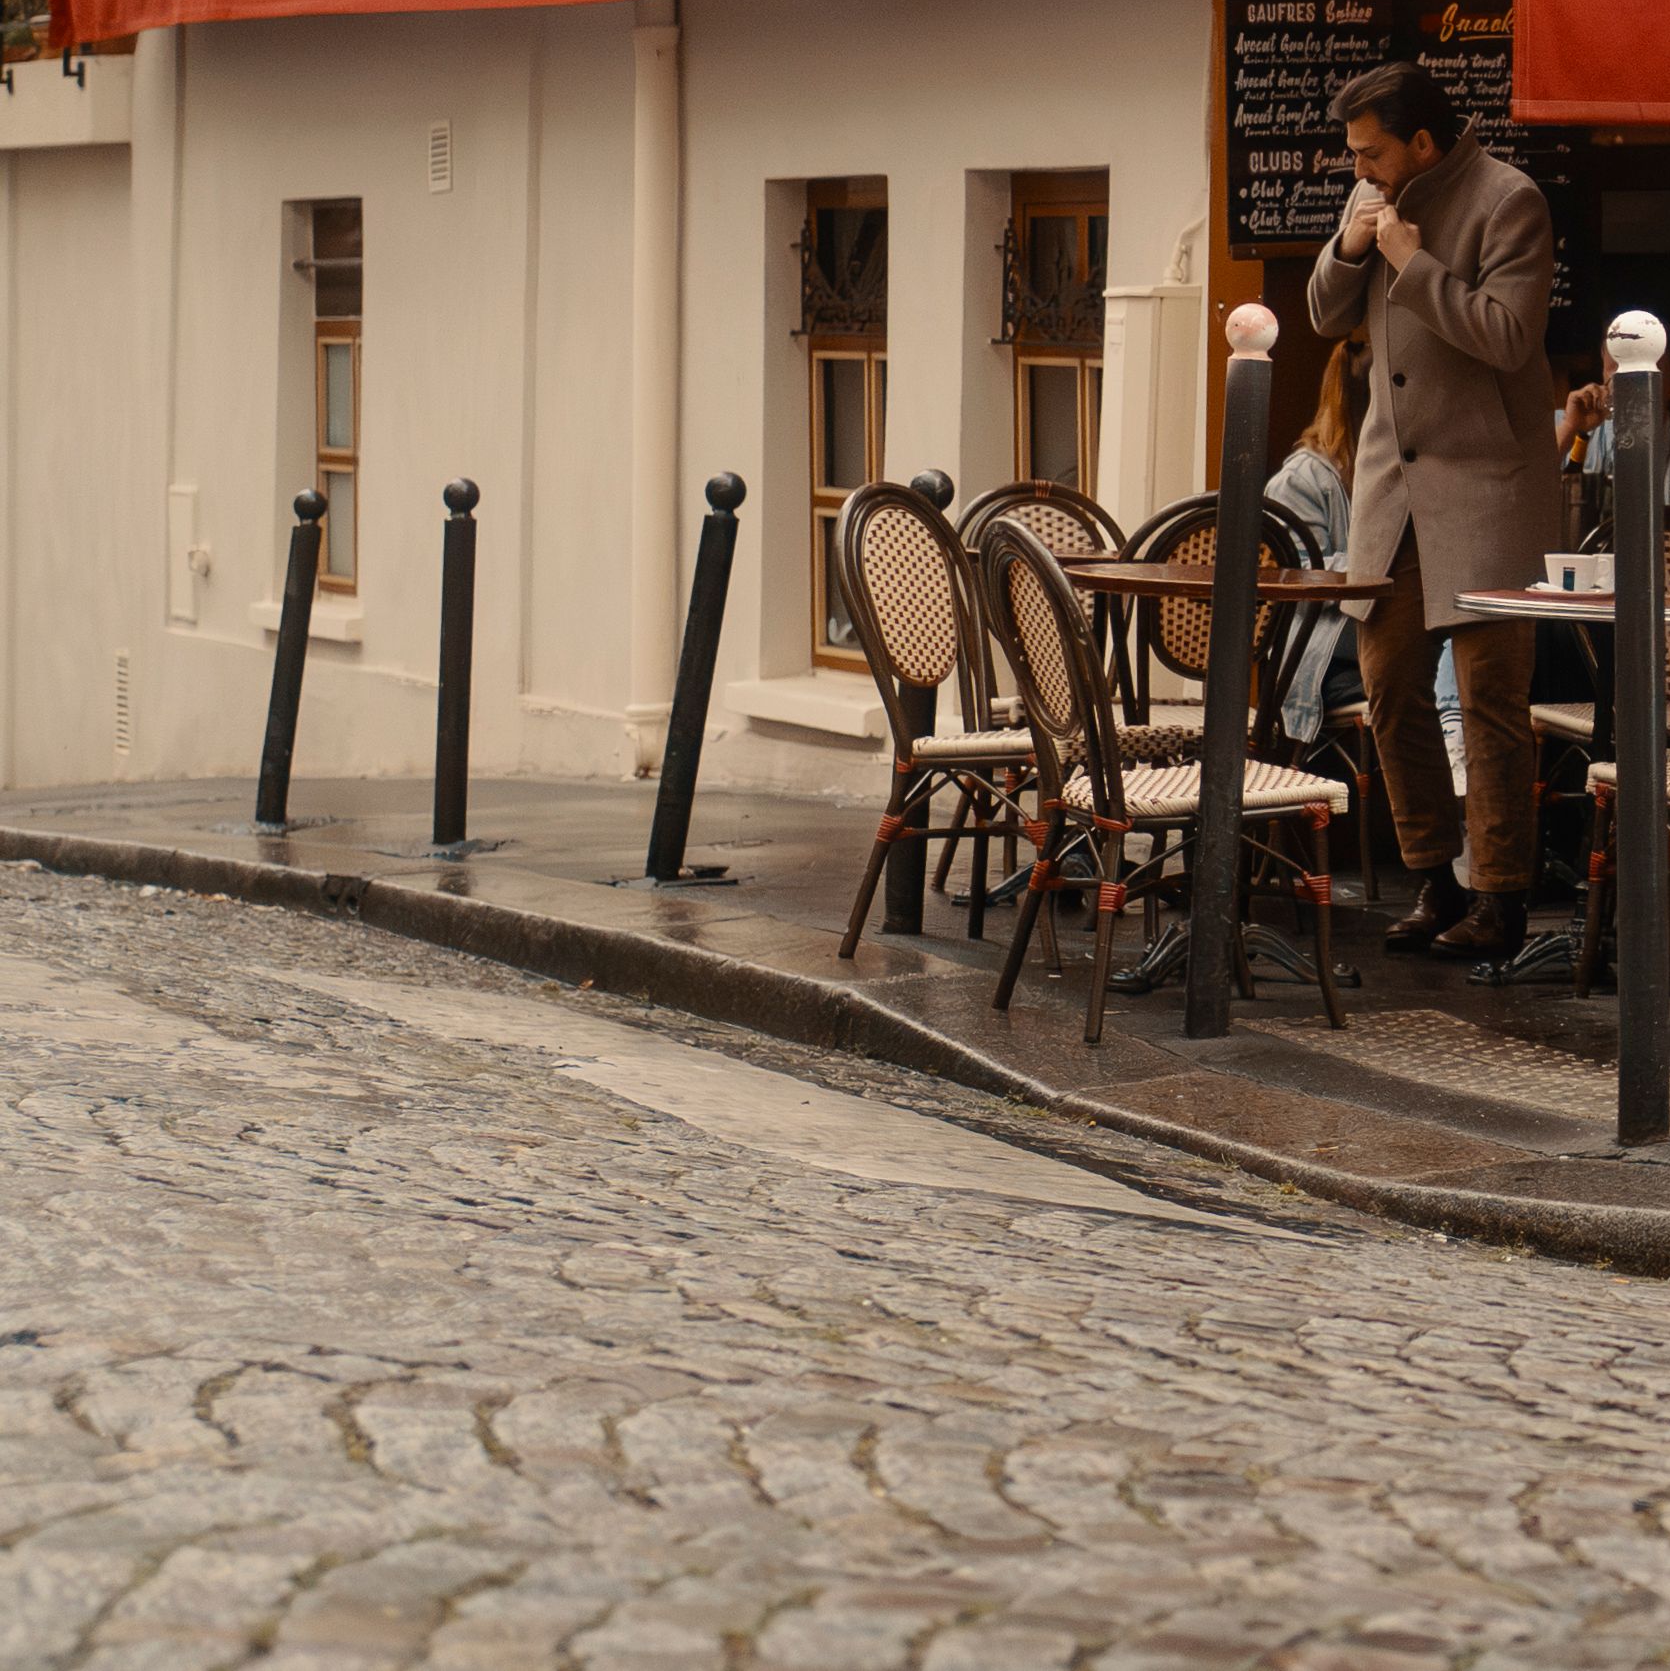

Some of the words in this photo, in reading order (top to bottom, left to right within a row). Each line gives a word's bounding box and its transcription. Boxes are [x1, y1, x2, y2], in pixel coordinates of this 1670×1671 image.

[1247, 2, 1317, 23] GAUFRES
[1249, 151, 1304, 174] CLUBS
[1250, 178, 1285, 199] Club
[1249, 210, 1281, 230] Club
